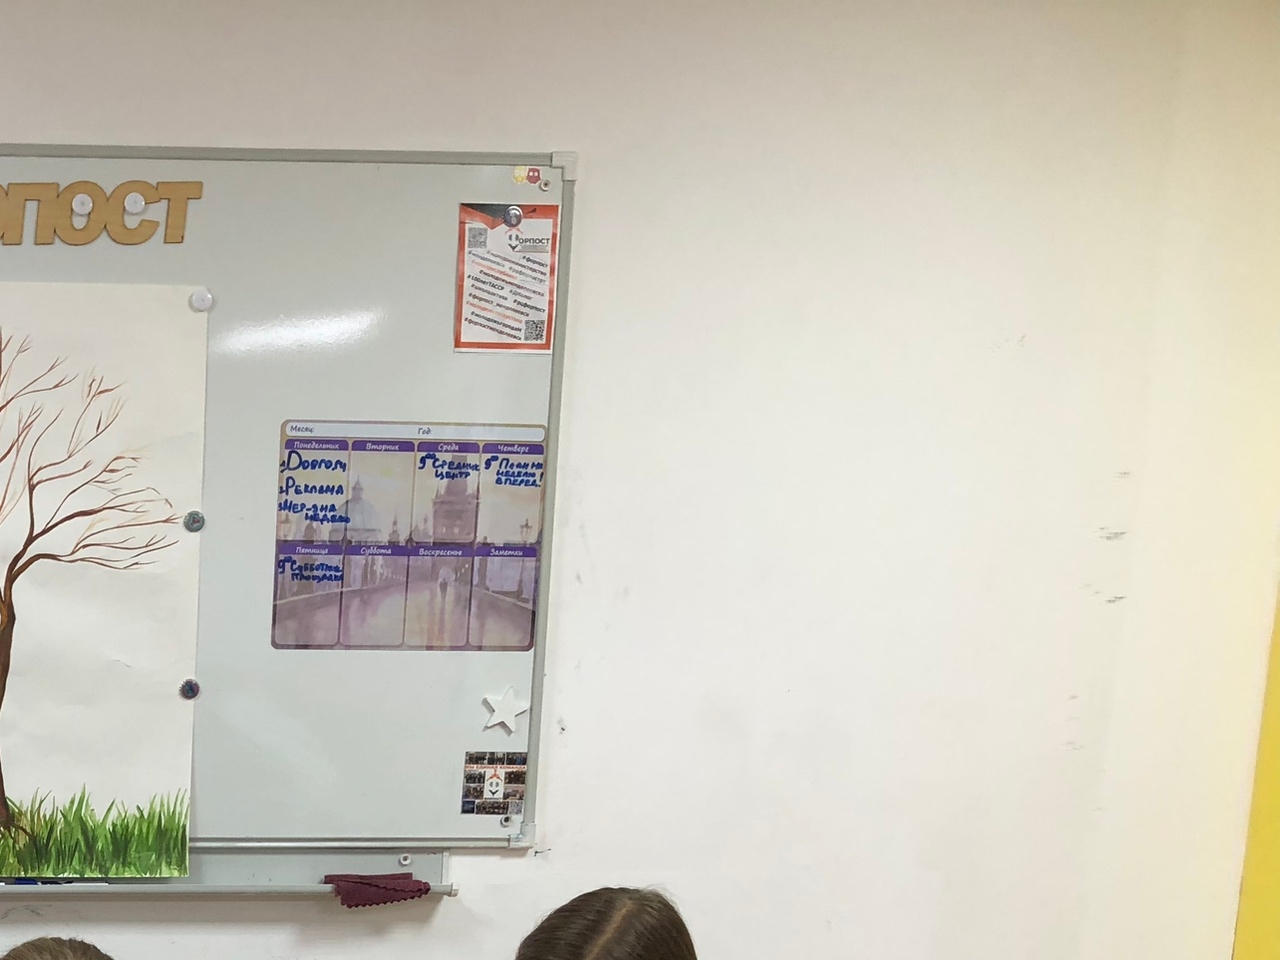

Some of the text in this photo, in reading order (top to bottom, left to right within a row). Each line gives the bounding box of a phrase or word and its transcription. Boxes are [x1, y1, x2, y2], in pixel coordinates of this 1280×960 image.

[293, 441, 340, 450] Понедельник
[365, 442, 400, 452] Вторник
[437, 443, 460, 452] Среда
[497, 444, 529, 454] Четверг
[296, 546, 328, 554] Пятница
[360, 547, 392, 555] Суббота
[419, 548, 463, 557] Воскресенье
[490, 548, 523, 556] Заметки
